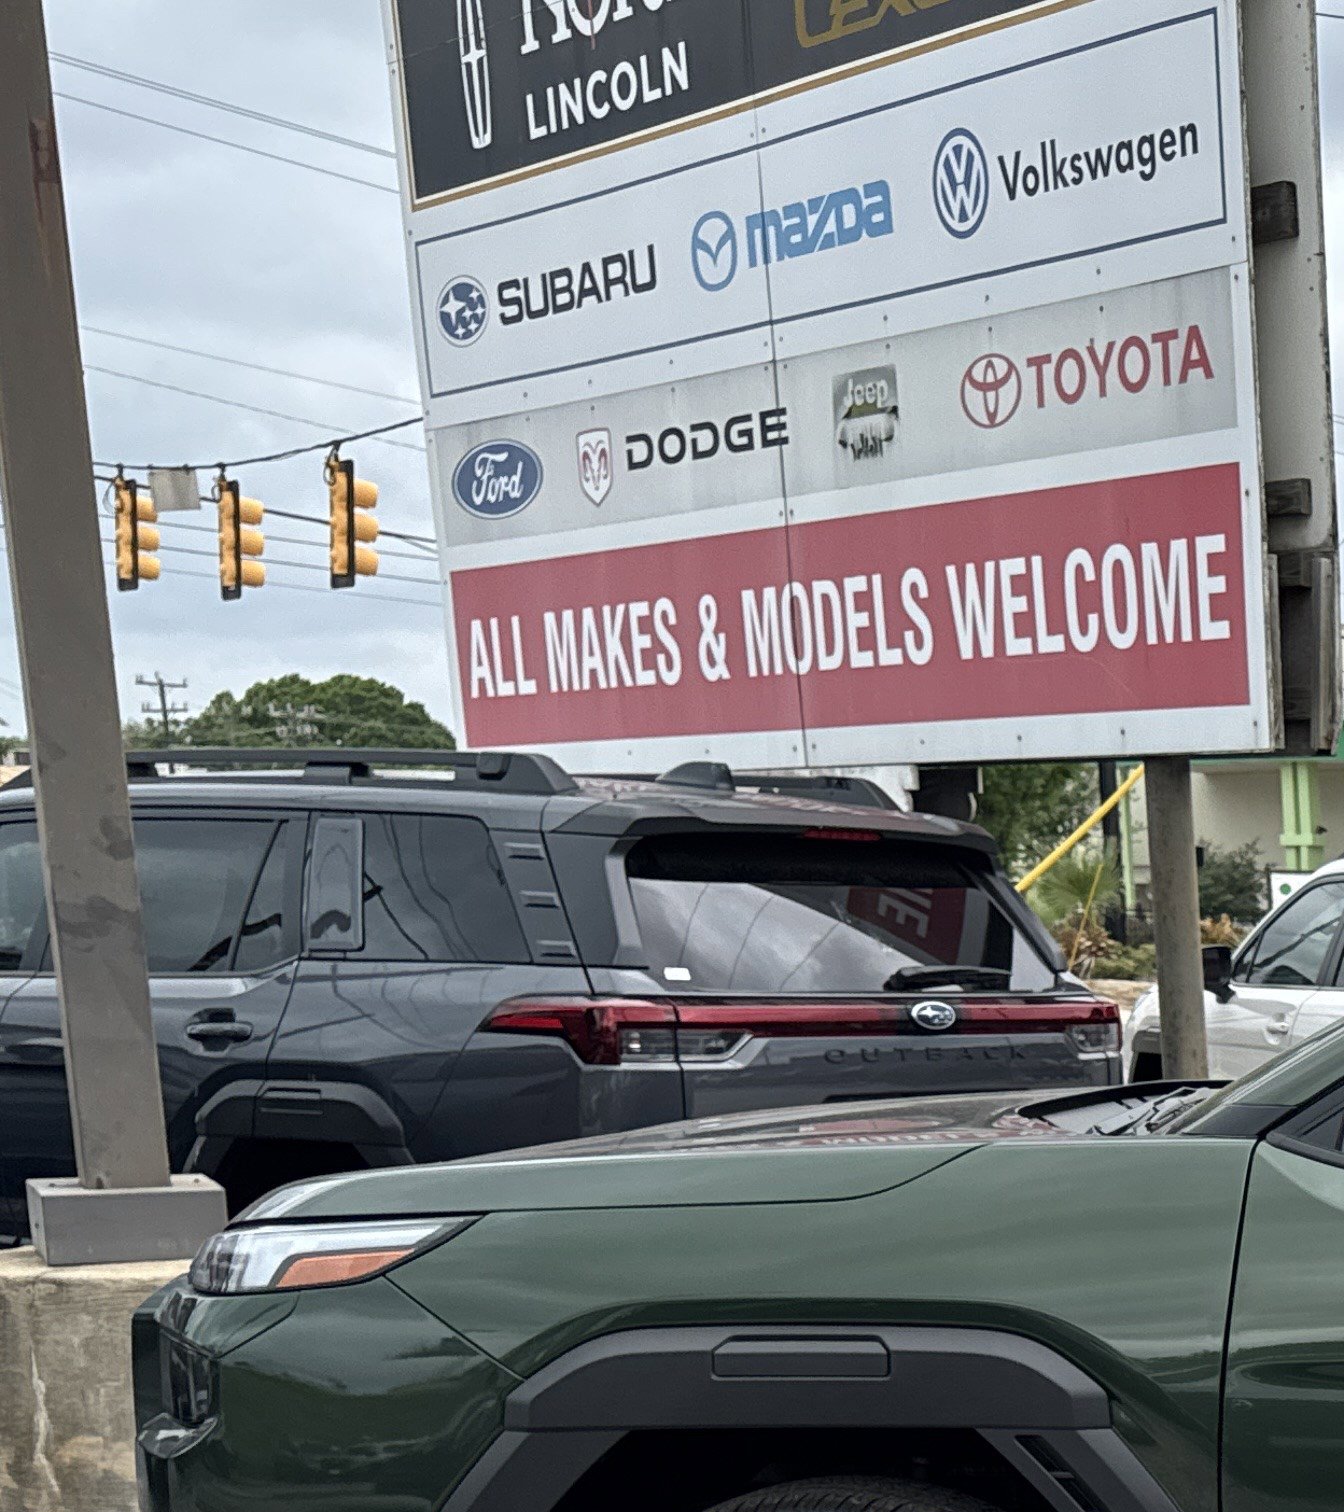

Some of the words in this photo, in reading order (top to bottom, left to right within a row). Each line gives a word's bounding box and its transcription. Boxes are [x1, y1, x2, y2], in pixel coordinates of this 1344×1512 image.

[525, 41, 690, 141] LINCOLN
[997, 121, 1200, 202] Volkswagen
[496, 243, 658, 326] SUBARU
[1026, 324, 1215, 410] TOYOTA
[470, 450, 526, 503] Ford
[625, 406, 790, 471] DODGE
[469, 614, 538, 699] ALL
[543, 597, 682, 694] MAKES
[697, 593, 733, 683] &
[744, 566, 935, 678] MODELS
[945, 533, 1232, 662] WELCOME
